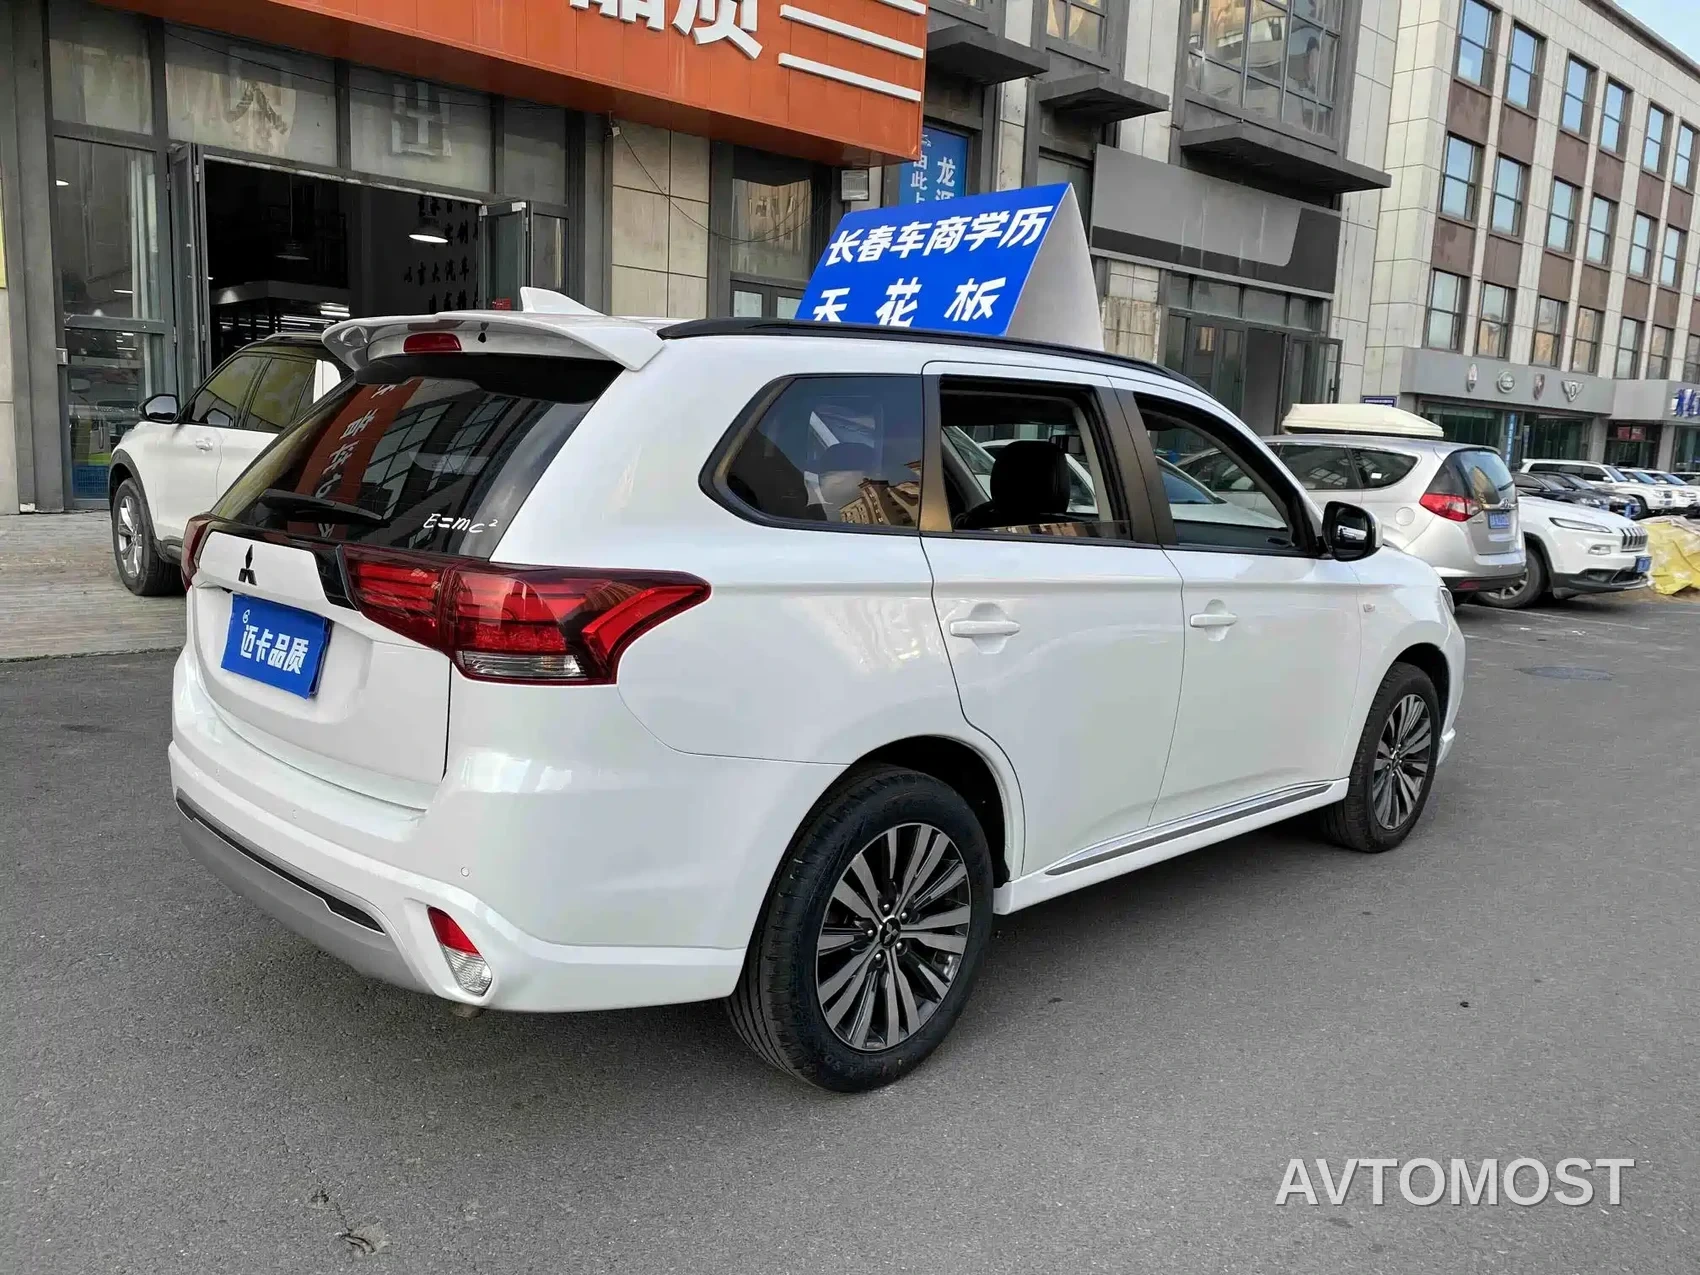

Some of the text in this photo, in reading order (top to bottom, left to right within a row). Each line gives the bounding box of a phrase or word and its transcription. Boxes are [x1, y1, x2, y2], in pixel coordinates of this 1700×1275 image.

[825, 205, 1053, 267] 长春车商学历
[811, 276, 1007, 327] 天花板
[240, 624, 310, 675] 迈卡品质
